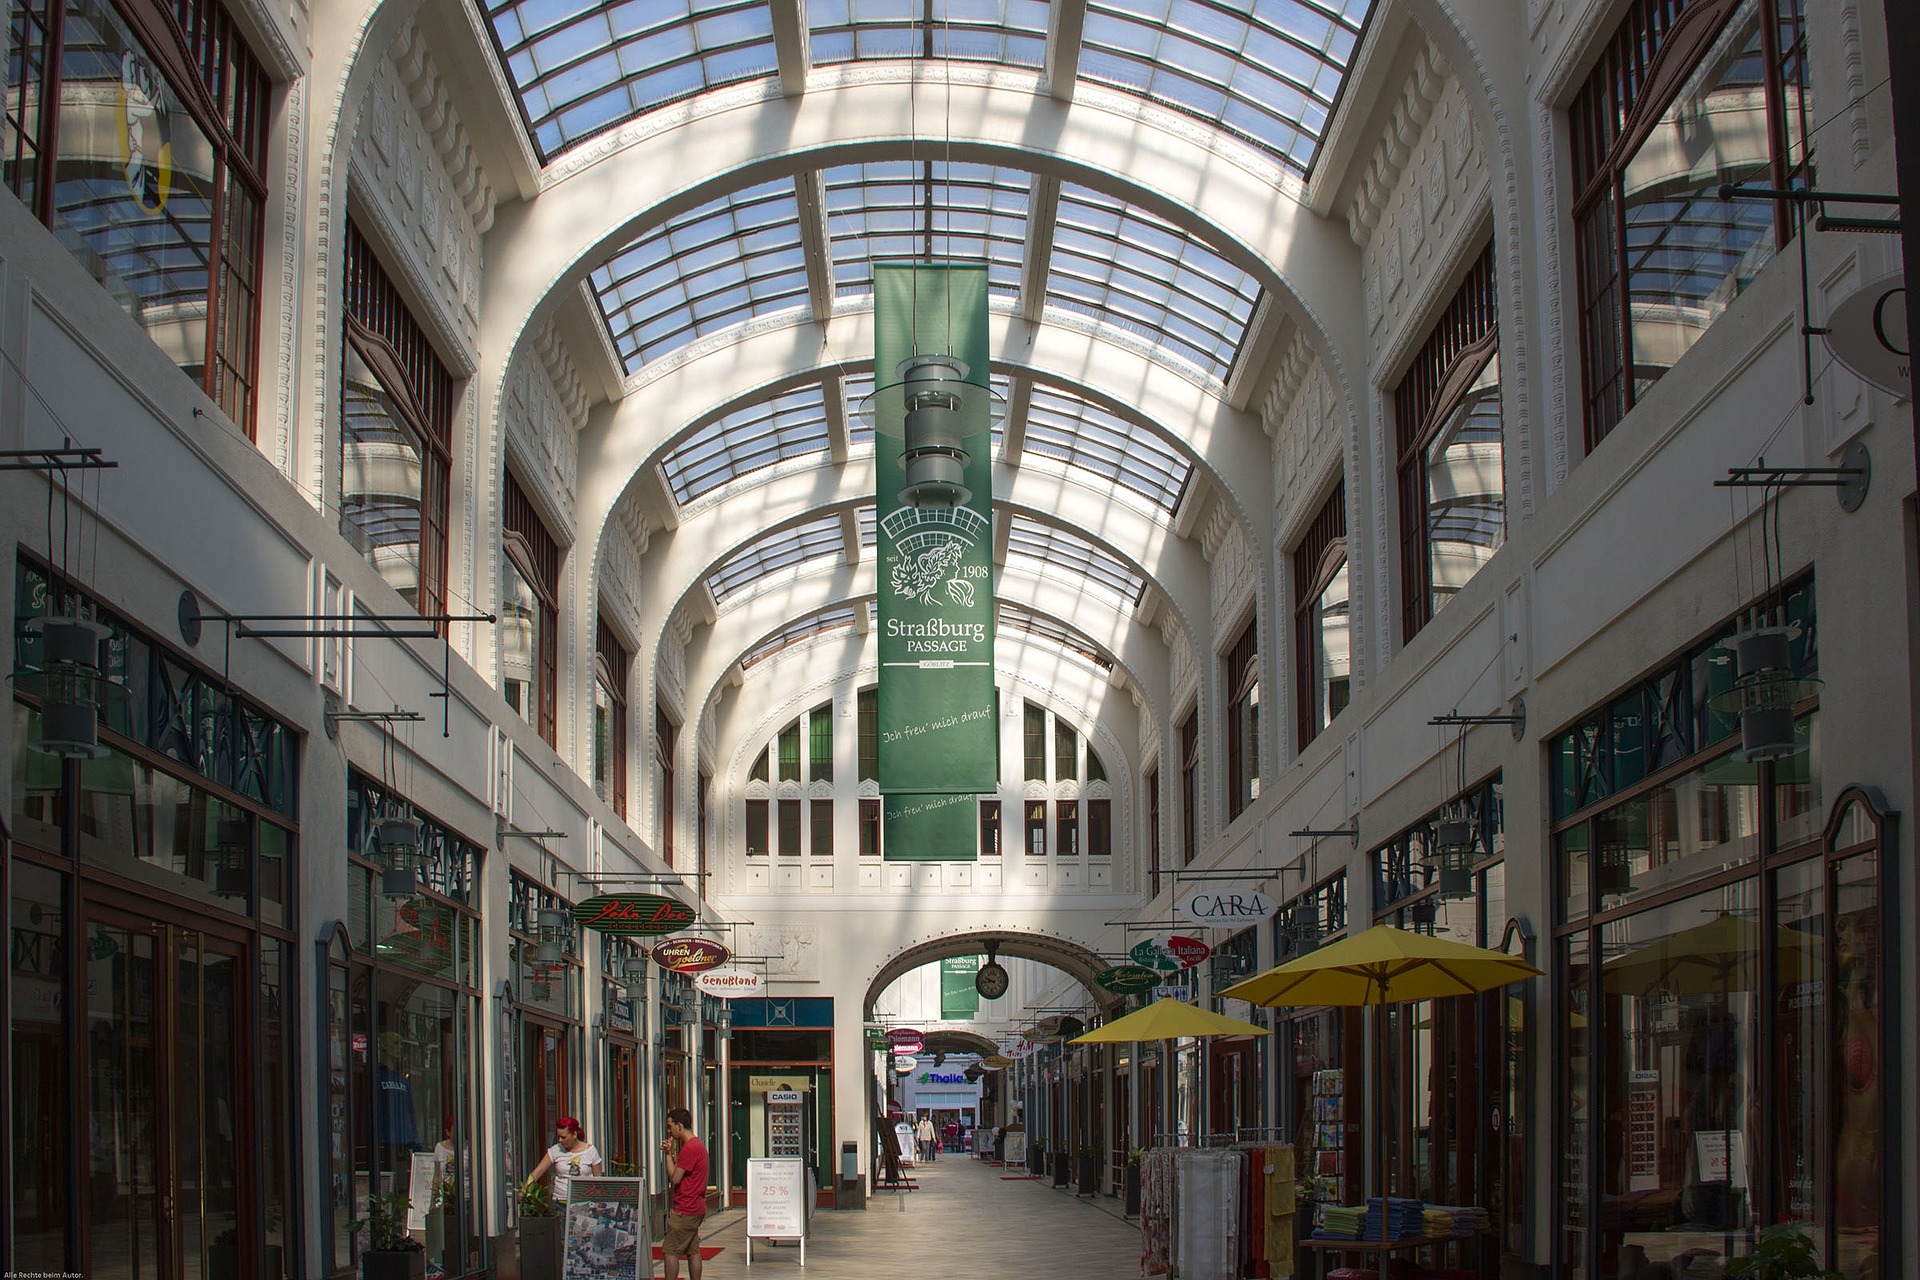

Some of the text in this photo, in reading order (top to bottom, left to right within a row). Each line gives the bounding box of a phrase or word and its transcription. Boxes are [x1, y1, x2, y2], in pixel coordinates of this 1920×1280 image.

[963, 565, 989, 578] 1908
[887, 618, 985, 642] Straßburg
[907, 640, 967, 652] PASSAGE
[923, 660, 950, 668] GÖRLITZ
[931, 715, 958, 730] mich
[961, 704, 991, 723] drauf
[925, 798, 947, 811] mich
[949, 793, 973, 804] drauf
[1191, 894, 1267, 917] CARA
[580, 900, 688, 925] John Doe
[663, 948, 691, 956] UHREN
[1134, 946, 1144, 956] La
[1178, 945, 1205, 955] Italiana
[945, 957, 977, 966] Straßburg
[702, 974, 757, 988] Genußland
[1017, 1040, 1034, 1051] H&M
[930, 1073, 963, 1083] Thalia
[762, 1185, 789, 1196] 25 %
